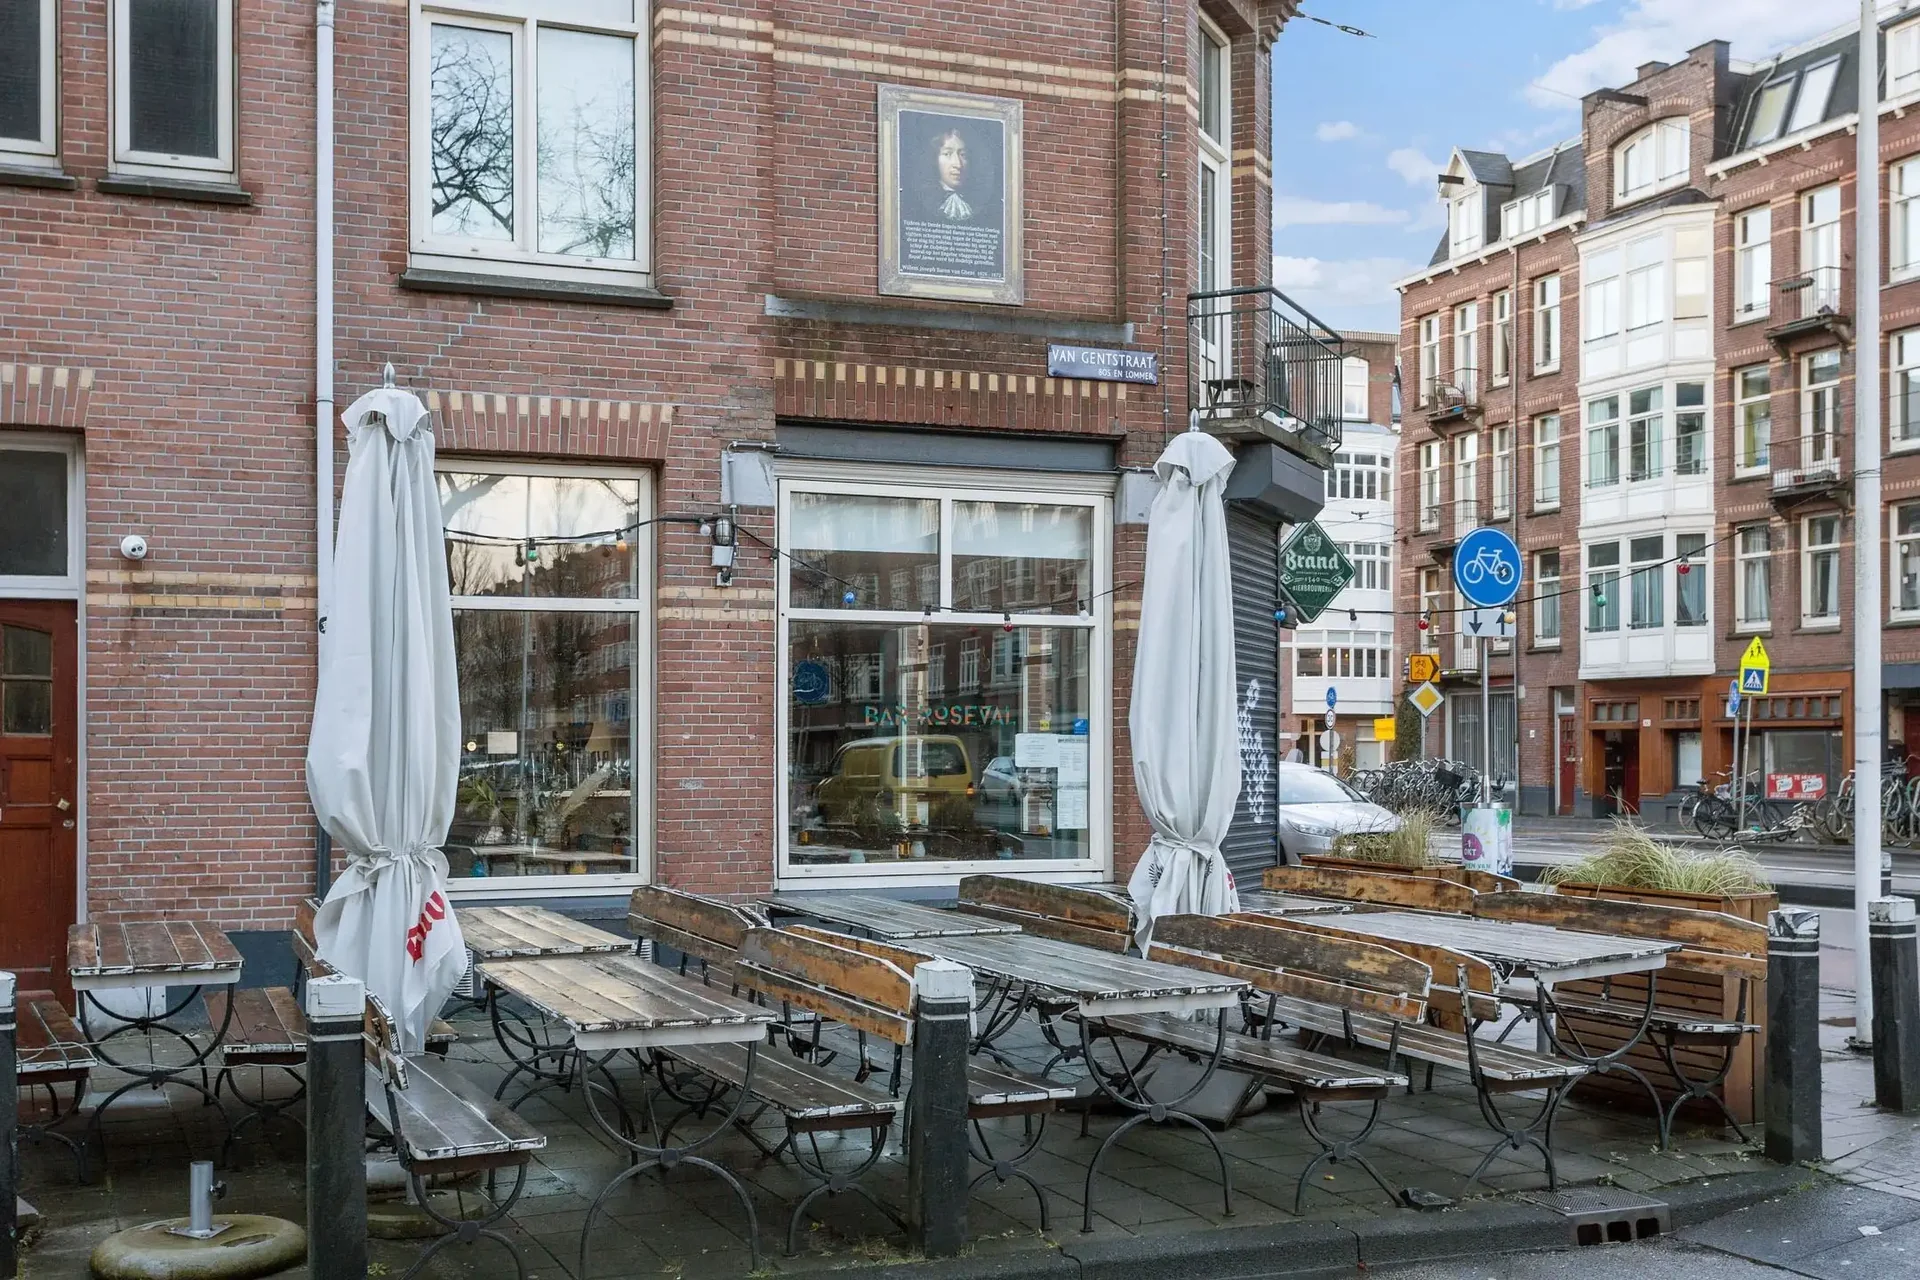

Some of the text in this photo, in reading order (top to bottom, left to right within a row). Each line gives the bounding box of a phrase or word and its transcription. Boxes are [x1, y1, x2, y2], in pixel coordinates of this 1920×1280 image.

[1052, 349, 1153, 369] VAN GENTSTRAAT
[1098, 368, 1154, 380] BOS EN LOMMER
[1285, 549, 1339, 570] Brand
[865, 705, 1016, 726] BAR ROSEVAL
